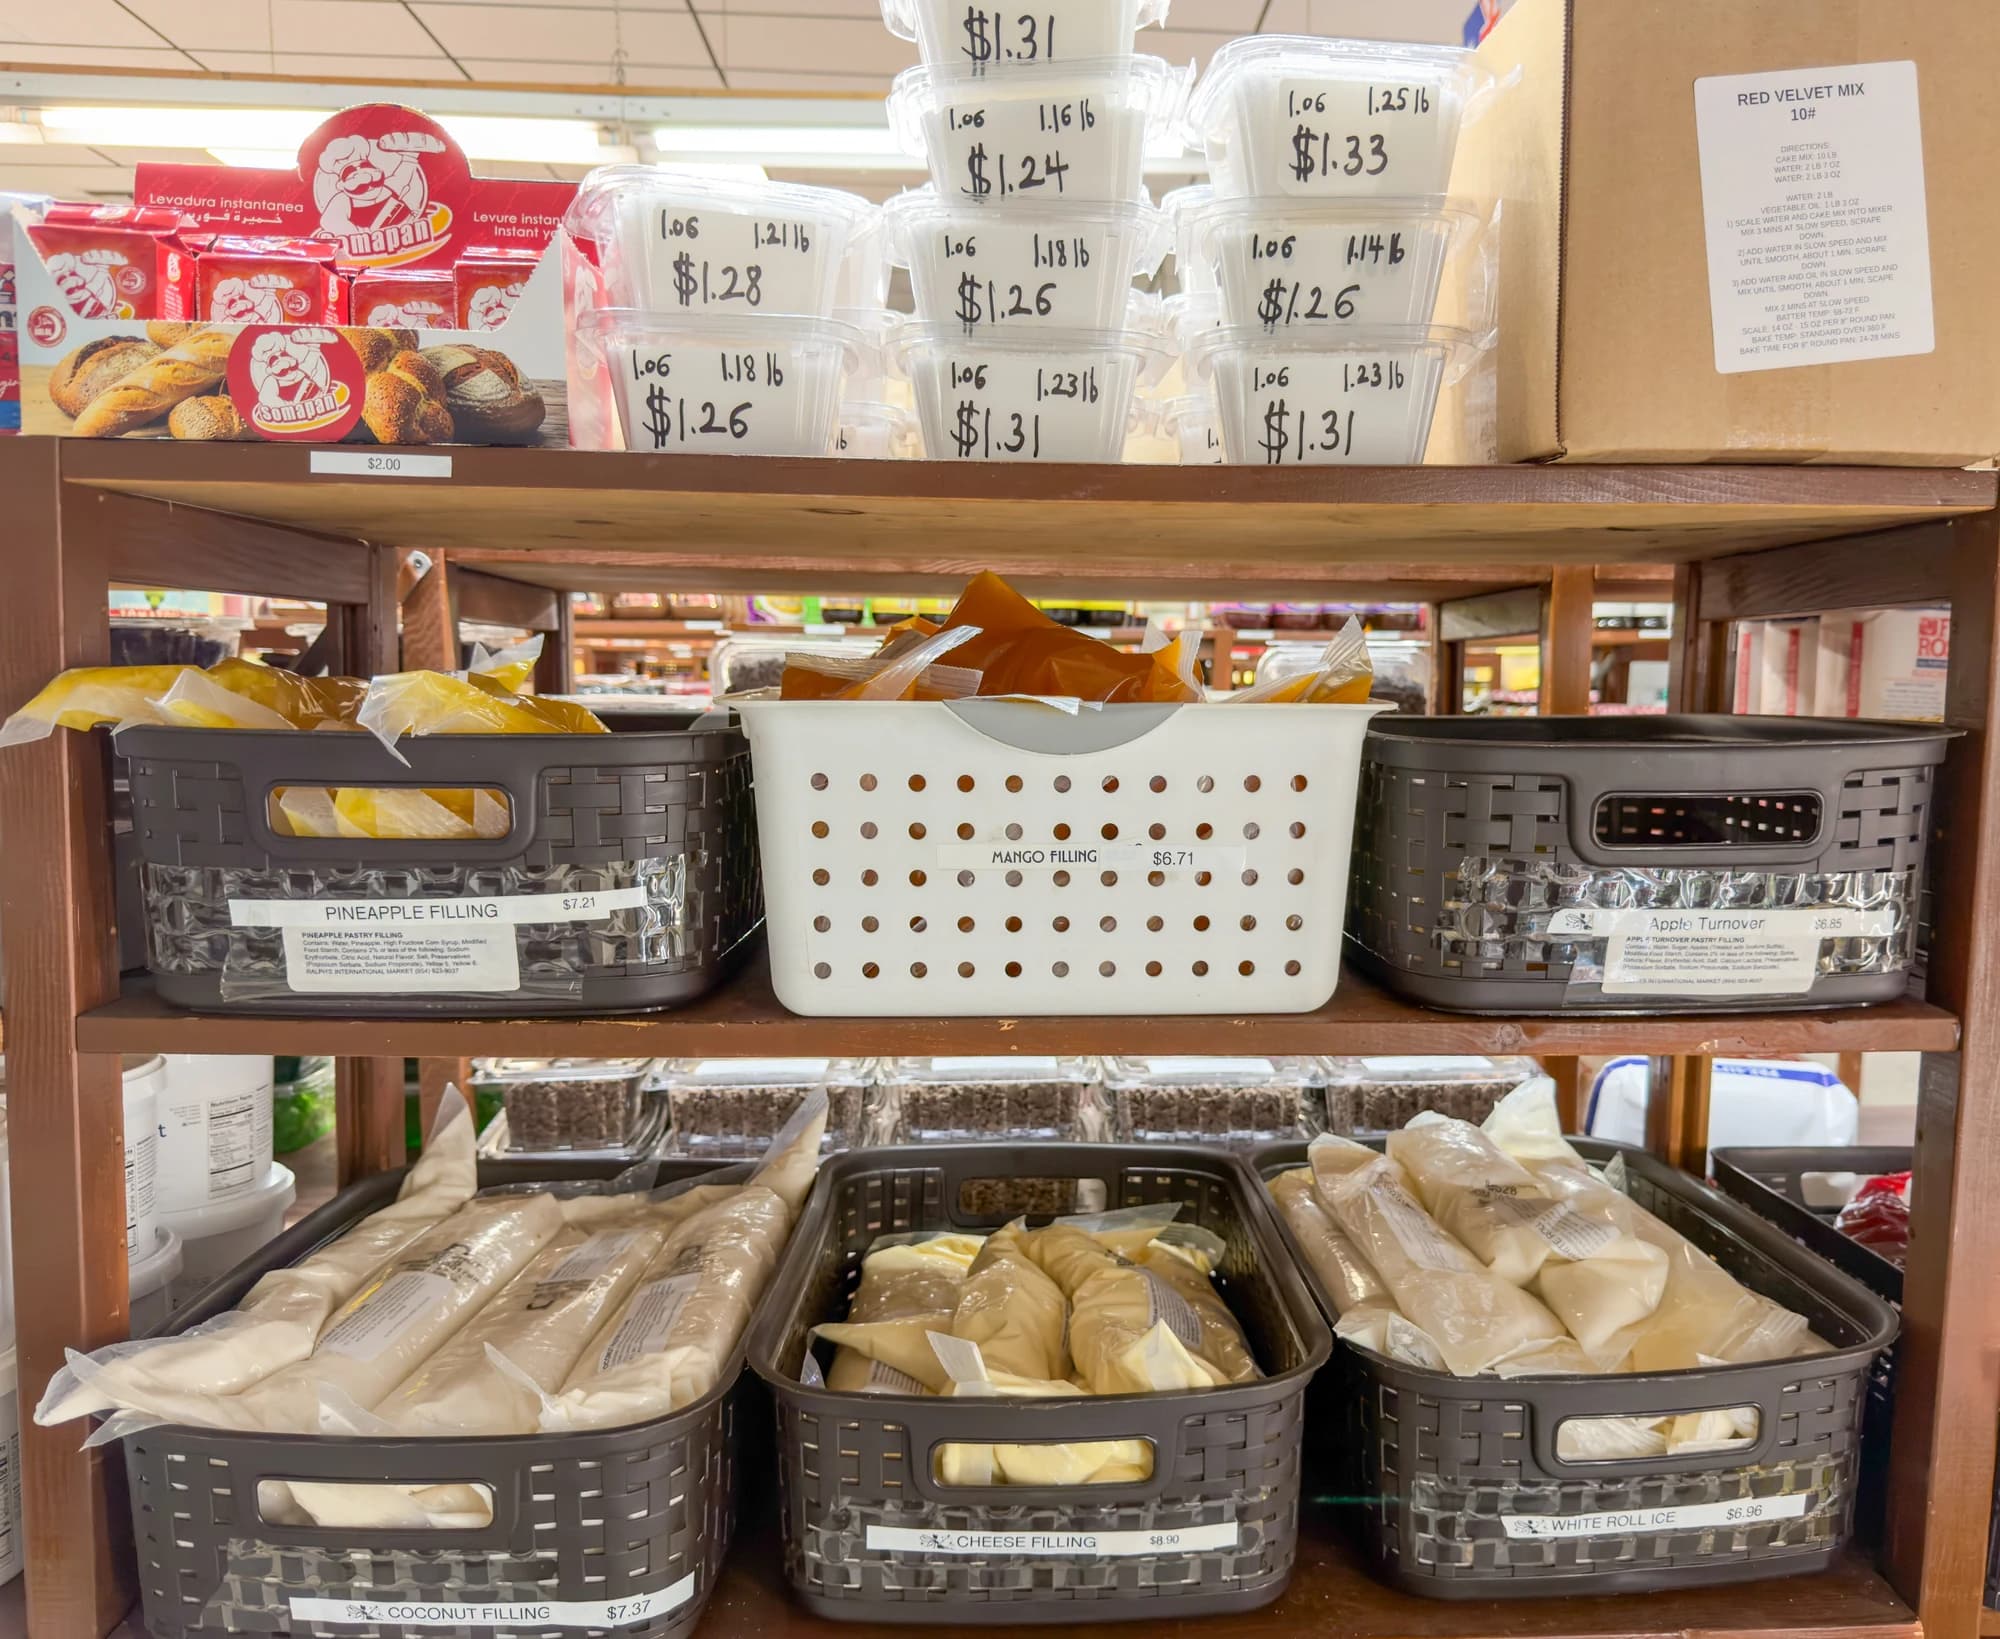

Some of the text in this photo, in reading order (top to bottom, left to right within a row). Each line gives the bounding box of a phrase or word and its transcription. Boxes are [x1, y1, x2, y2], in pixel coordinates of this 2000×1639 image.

[963, 6, 1055, 62] $1.31
[1288, 90, 1327, 118] 1.06
[1368, 86, 1410, 116] 1.25
[1738, 83, 1865, 106] RED VELVET MIX
[948, 109, 986, 131] 1.06
[1039, 105, 1072, 133] 1.16
[1790, 107, 1817, 121] 10#
[1288, 124, 1389, 183] $1.33
[961, 143, 1069, 196] $1.24
[149, 193, 304, 213] Levadura instantanea
[473, 211, 518, 224] Levure
[495, 225, 539, 238] Instant
[660, 209, 699, 239] 1.06
[754, 223, 788, 249] 1.21
[945, 236, 977, 257] 1.06
[1033, 234, 1067, 268] 1.18
[1252, 234, 1297, 260] 1.06
[1346, 234, 1385, 265] 1.14
[673, 252, 763, 306] $1.28
[956, 272, 1057, 327] $1.26
[1257, 278, 1361, 327] $1.26
[632, 349, 672, 381] 1.06
[721, 353, 757, 382] 1.18
[1254, 367, 1290, 391] 1.06
[1343, 362, 1382, 391] 1.23
[951, 362, 988, 389] 1.06
[1037, 368, 1079, 402] 1.23
[261, 395, 337, 423] Somapan
[642, 384, 753, 448] $1.26
[950, 401, 1041, 458] $1.31
[1257, 399, 1355, 464] $1.31
[367, 457, 402, 472] $2.00
[992, 849, 1194, 866] MANGO FILLING $6.71
[325, 897, 596, 921] PINEAPPLE FILLING $7.21
[374, 931, 403, 939] FILLING
[1649, 917, 1693, 934] Apple
[1697, 916, 1766, 931] Turnover
[1552, 1504, 1763, 1532] WHITE ROLL ICE $6.96
[957, 1534, 1180, 1549] CHEESE FILLING $8.90
[388, 1599, 651, 1621] COCONUT FILLING $7.37
